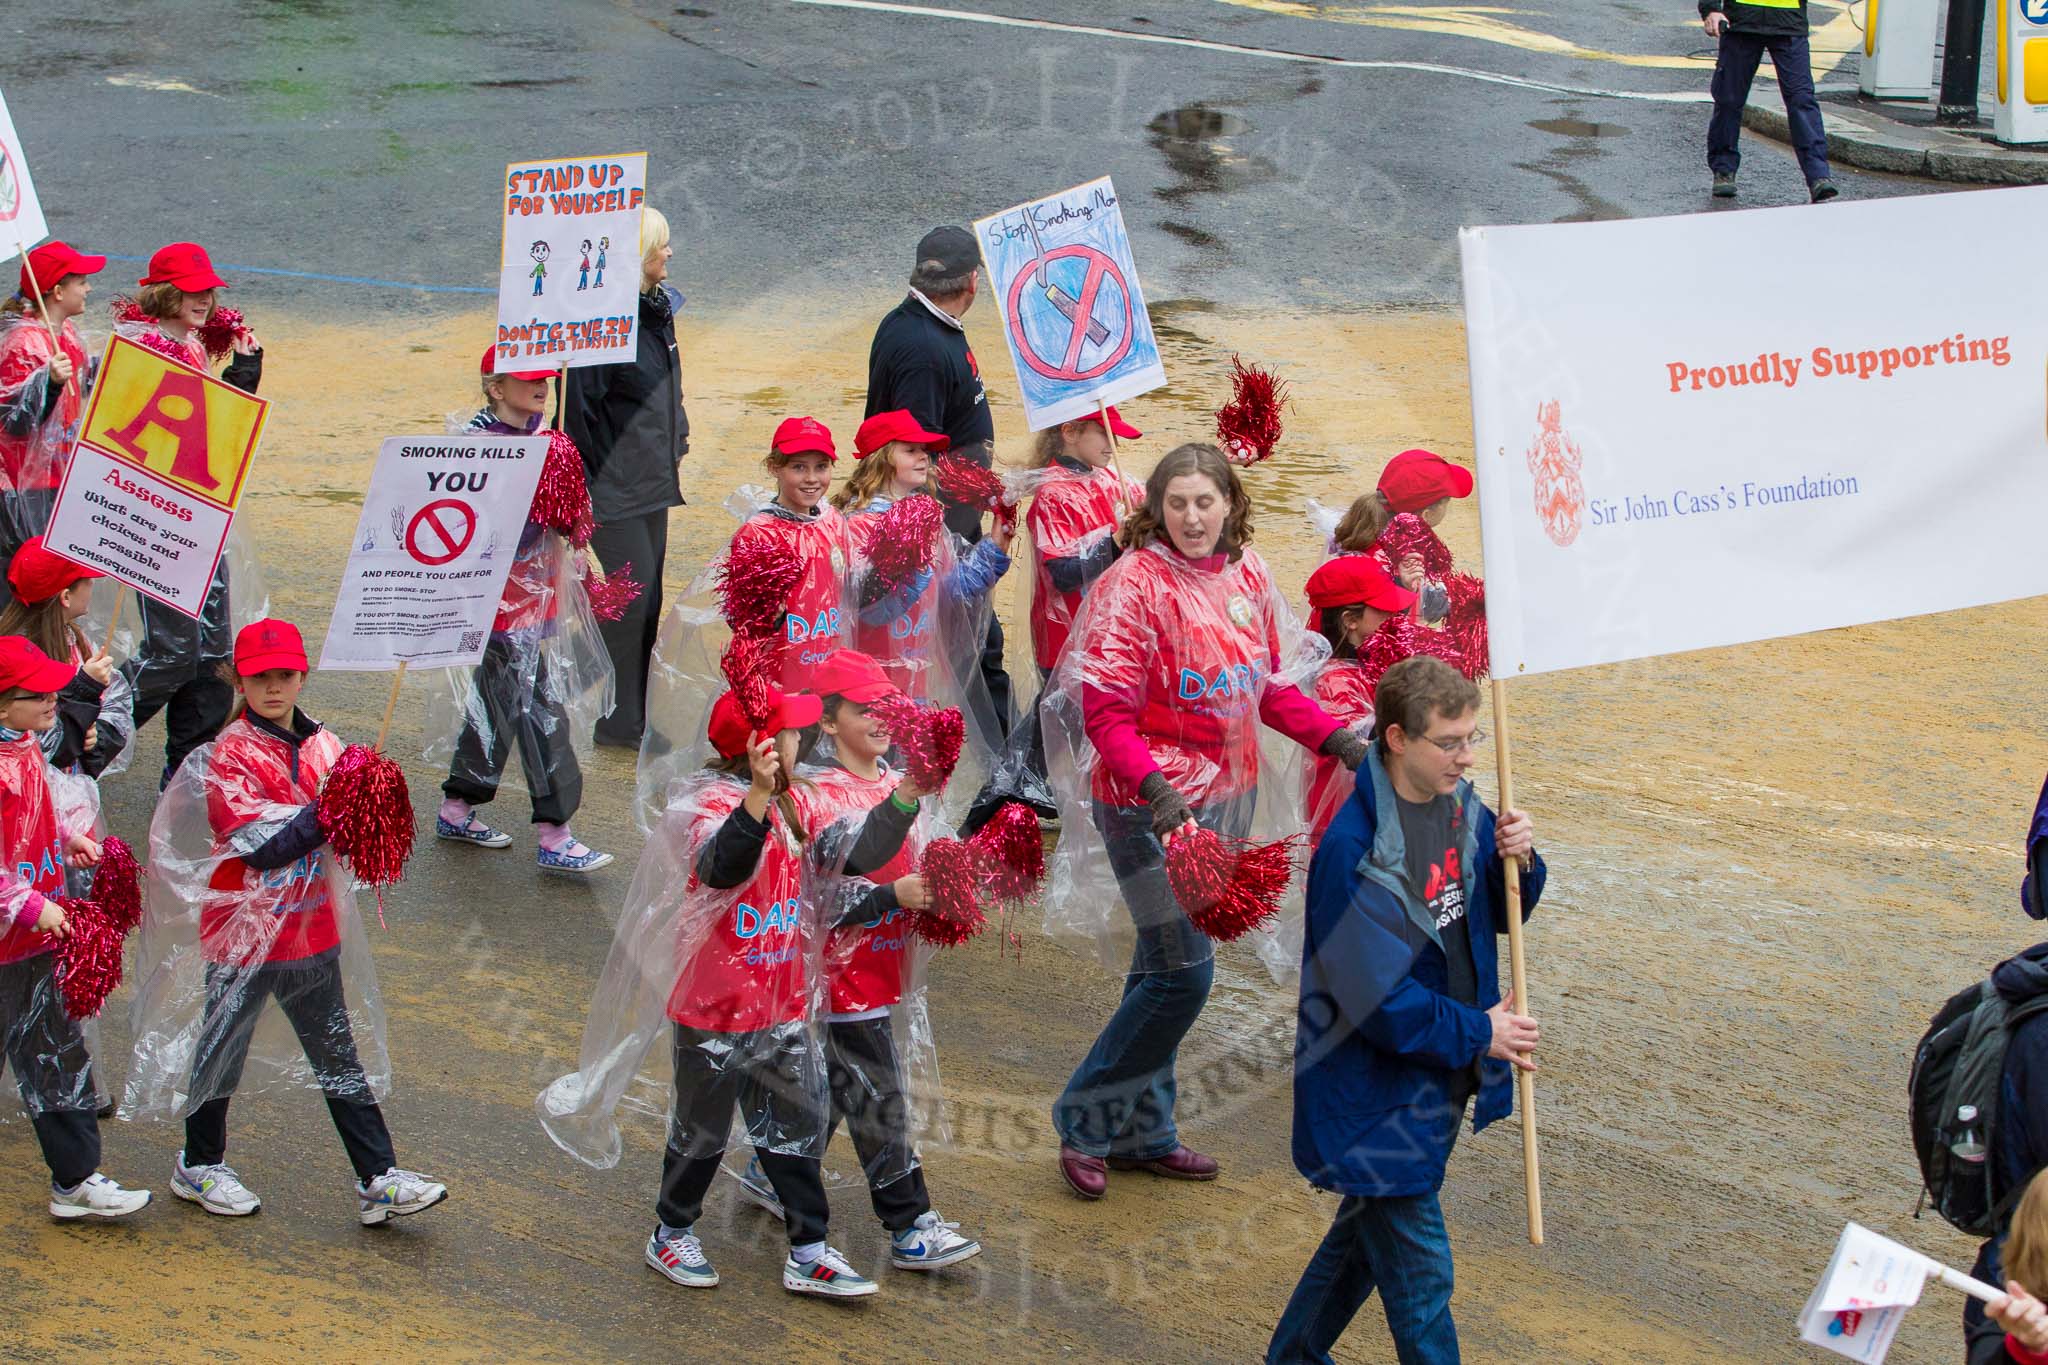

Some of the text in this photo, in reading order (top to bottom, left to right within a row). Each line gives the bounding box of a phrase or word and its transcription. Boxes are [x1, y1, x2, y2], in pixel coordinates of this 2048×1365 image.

[508, 164, 624, 194] STAND UP
[508, 187, 644, 216] FOR YOURSELF
[988, 220, 1028, 246] Stop
[1032, 201, 1094, 232] Smoking
[604, 315, 634, 335] IN
[497, 341, 520, 359] TO
[525, 338, 566, 356] PEER
[1665, 333, 2012, 393] Proudly Supporting
[401, 446, 526, 459] SMOKING KILLS
[103, 467, 194, 523] Assess
[427, 471, 489, 493] YOU
[1589, 472, 1859, 526] Sir John Cass's Foundation
[84, 489, 198, 550] What are your
[91, 514, 180, 561] choices and
[68, 541, 182, 598] consequences?
[98, 535, 162, 571] possible
[361, 569, 493, 580] AND PEOPLE YOU CARE FOR
